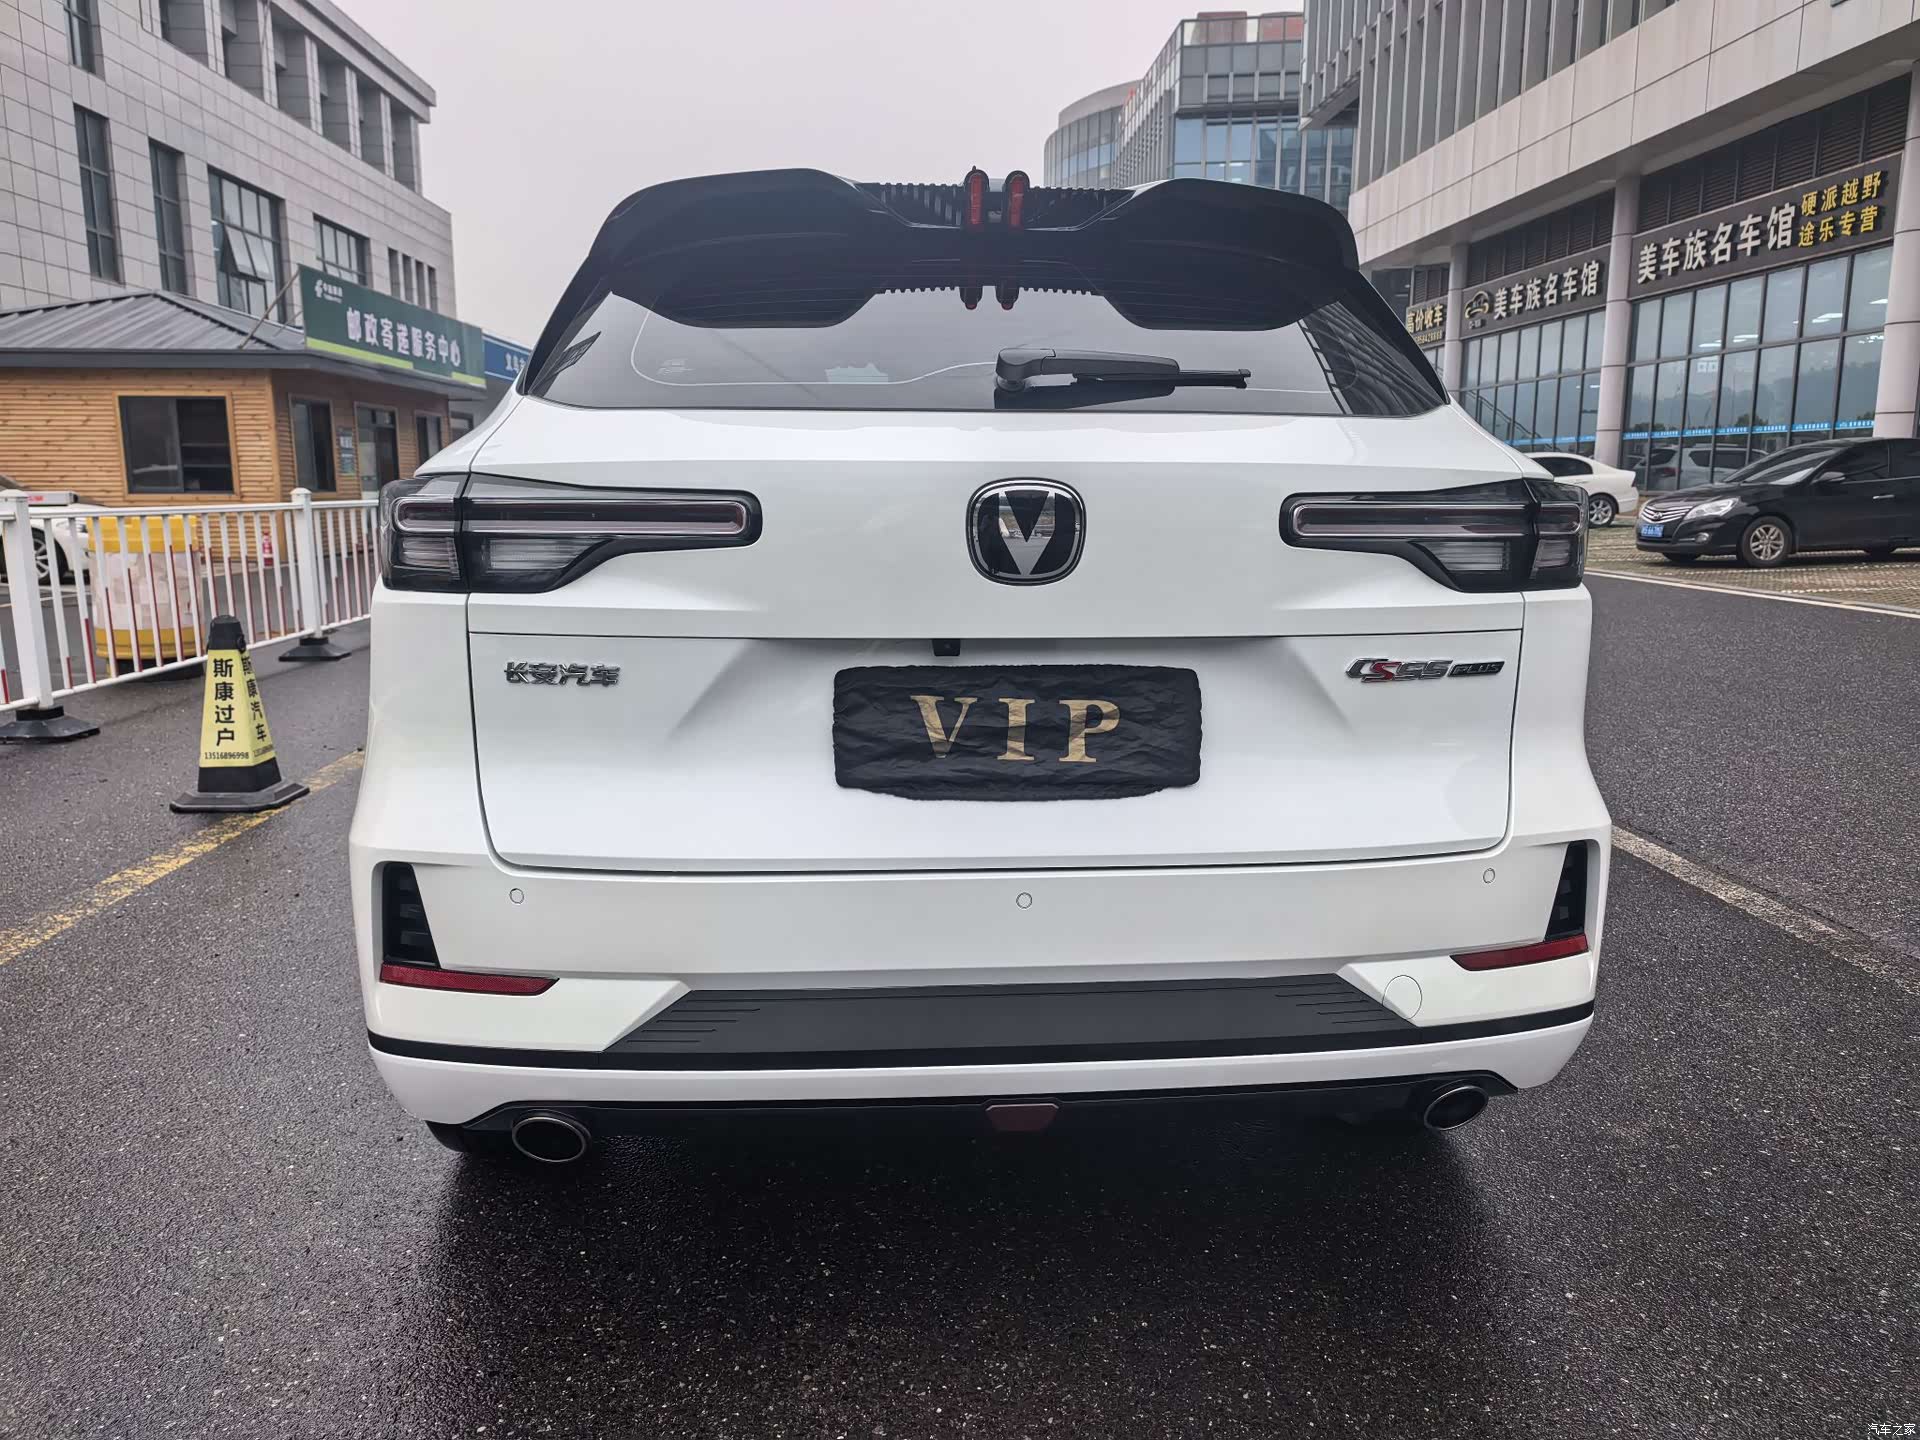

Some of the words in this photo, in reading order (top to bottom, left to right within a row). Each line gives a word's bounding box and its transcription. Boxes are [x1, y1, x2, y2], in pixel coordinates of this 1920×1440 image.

[1801, 170, 1882, 216] 硬派越野
[1637, 202, 1796, 284] 美车族名车馆
[1798, 205, 1879, 248] 途乐专营
[1493, 260, 1599, 321] 美车族名车馆
[1407, 303, 1444, 334] 高价收车
[505, 662, 621, 687] 长安汽车
[1346, 657, 1453, 683] CS55
[1451, 662, 1502, 676] PLUS
[213, 658, 235, 746] 斯康过户
[910, 695, 1121, 762] VIP
